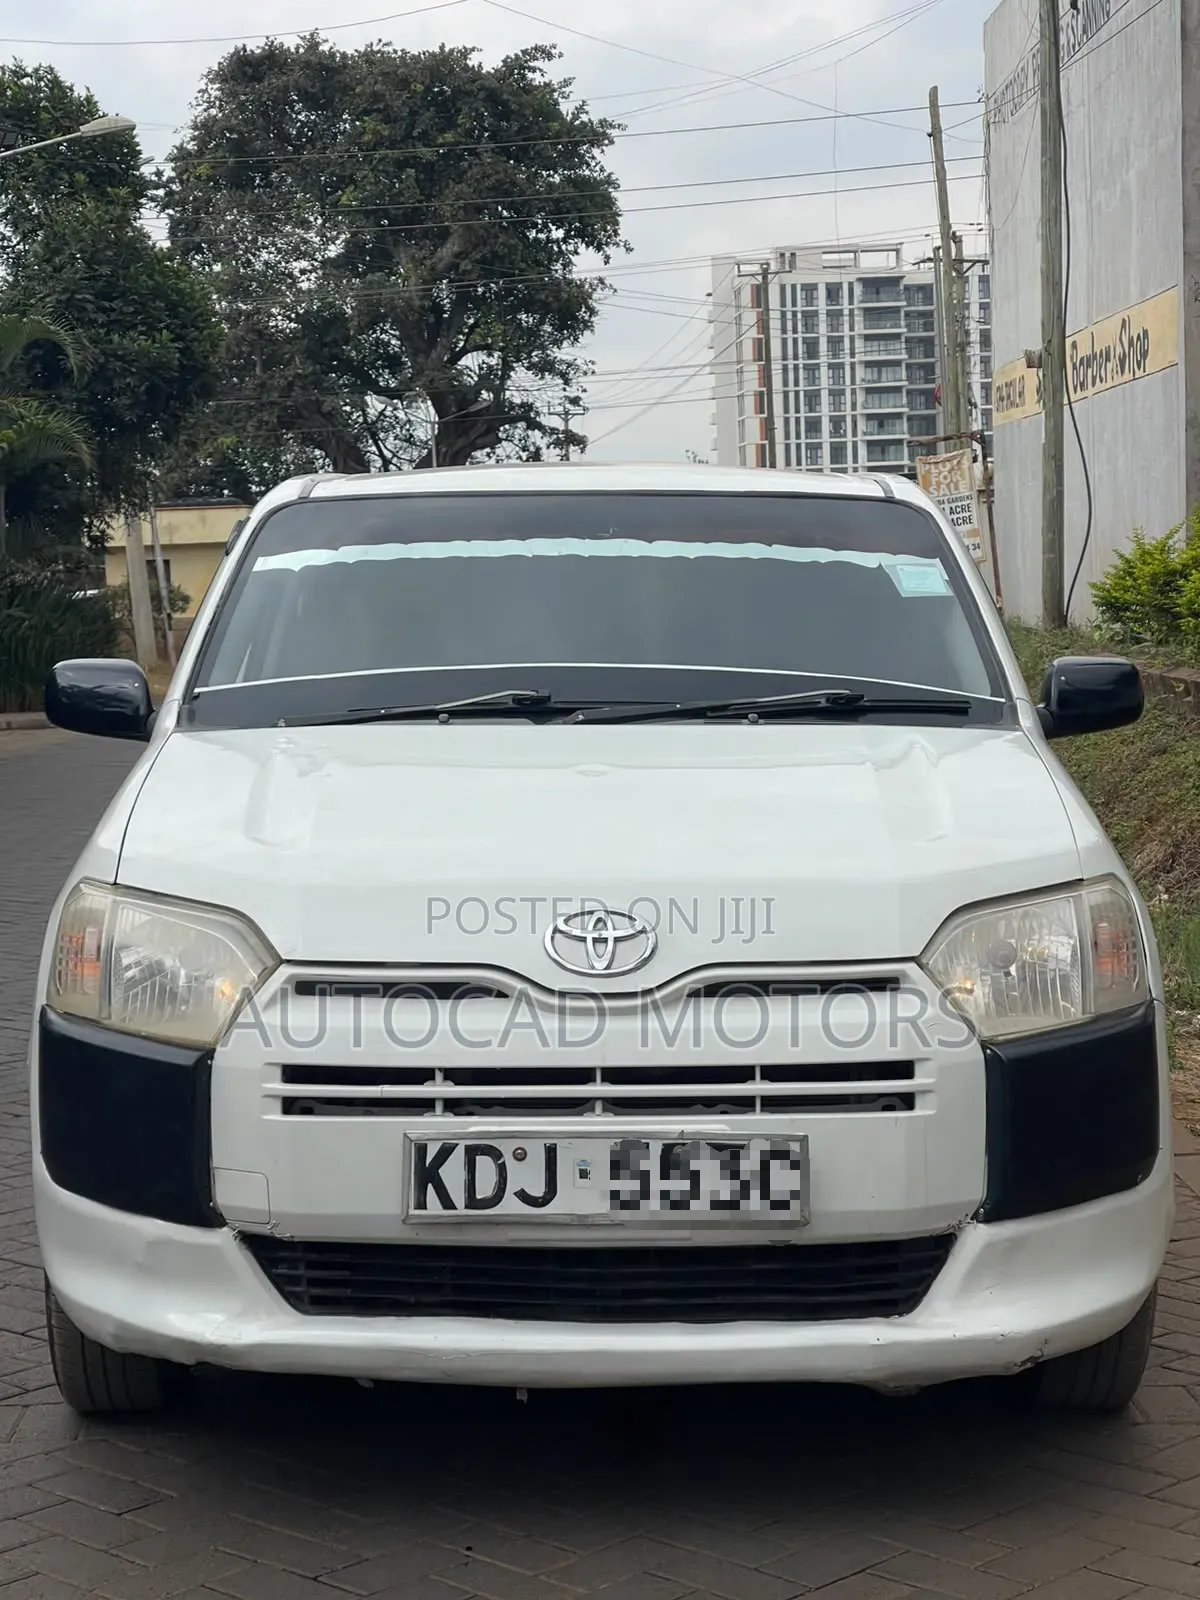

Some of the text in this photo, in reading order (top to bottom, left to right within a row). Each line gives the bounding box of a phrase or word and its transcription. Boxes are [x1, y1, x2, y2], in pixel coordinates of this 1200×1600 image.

[1070, 331, 1111, 394] Barber
[1118, 315, 1149, 378] Shop
[931, 468, 963, 484] FOR
[928, 480, 969, 498] SALE
[947, 494, 973, 505] GARDENS
[949, 503, 973, 516] ACRE
[412, 1142, 559, 1210] KDJ
